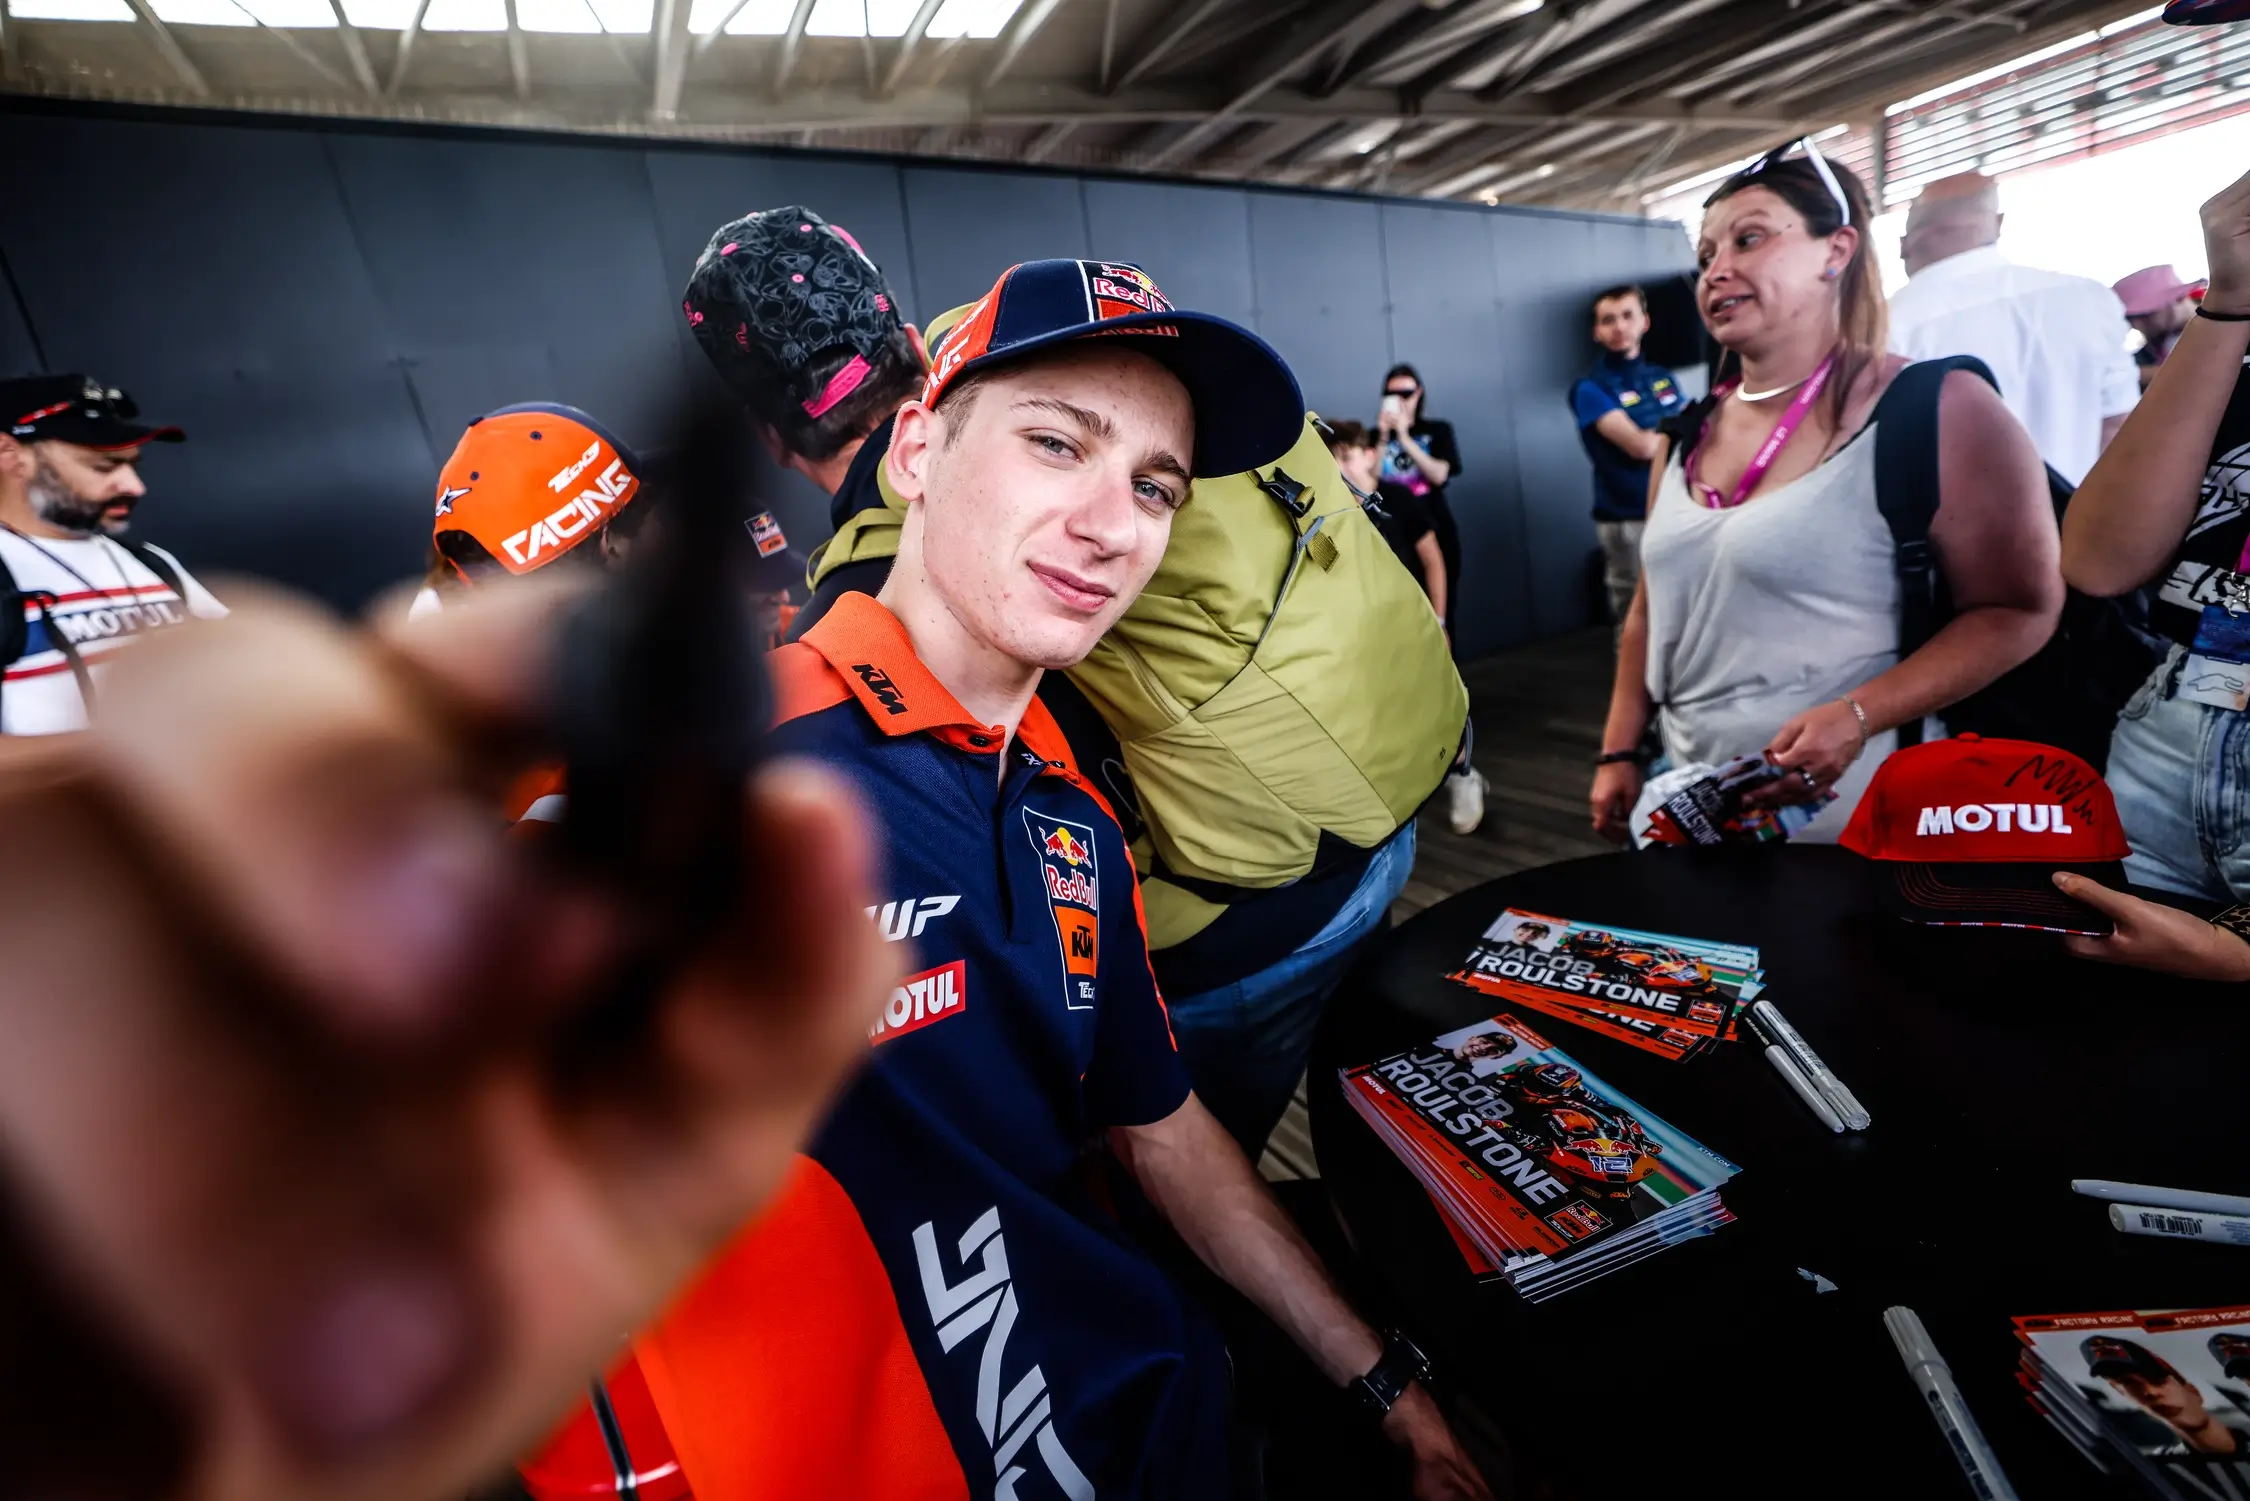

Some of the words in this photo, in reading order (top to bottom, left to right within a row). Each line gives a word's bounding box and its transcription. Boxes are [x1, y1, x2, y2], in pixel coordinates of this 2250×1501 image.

[851, 664, 908, 715] KTM
[1916, 802, 2072, 836] MOTUL
[1071, 925, 1093, 961] KTM
[1487, 945, 1596, 976] JACOB
[1477, 955, 1682, 1012] ROULSTONE
[1410, 1047, 1514, 1120] JACOB
[1377, 1058, 1570, 1206] ROULSTONE
